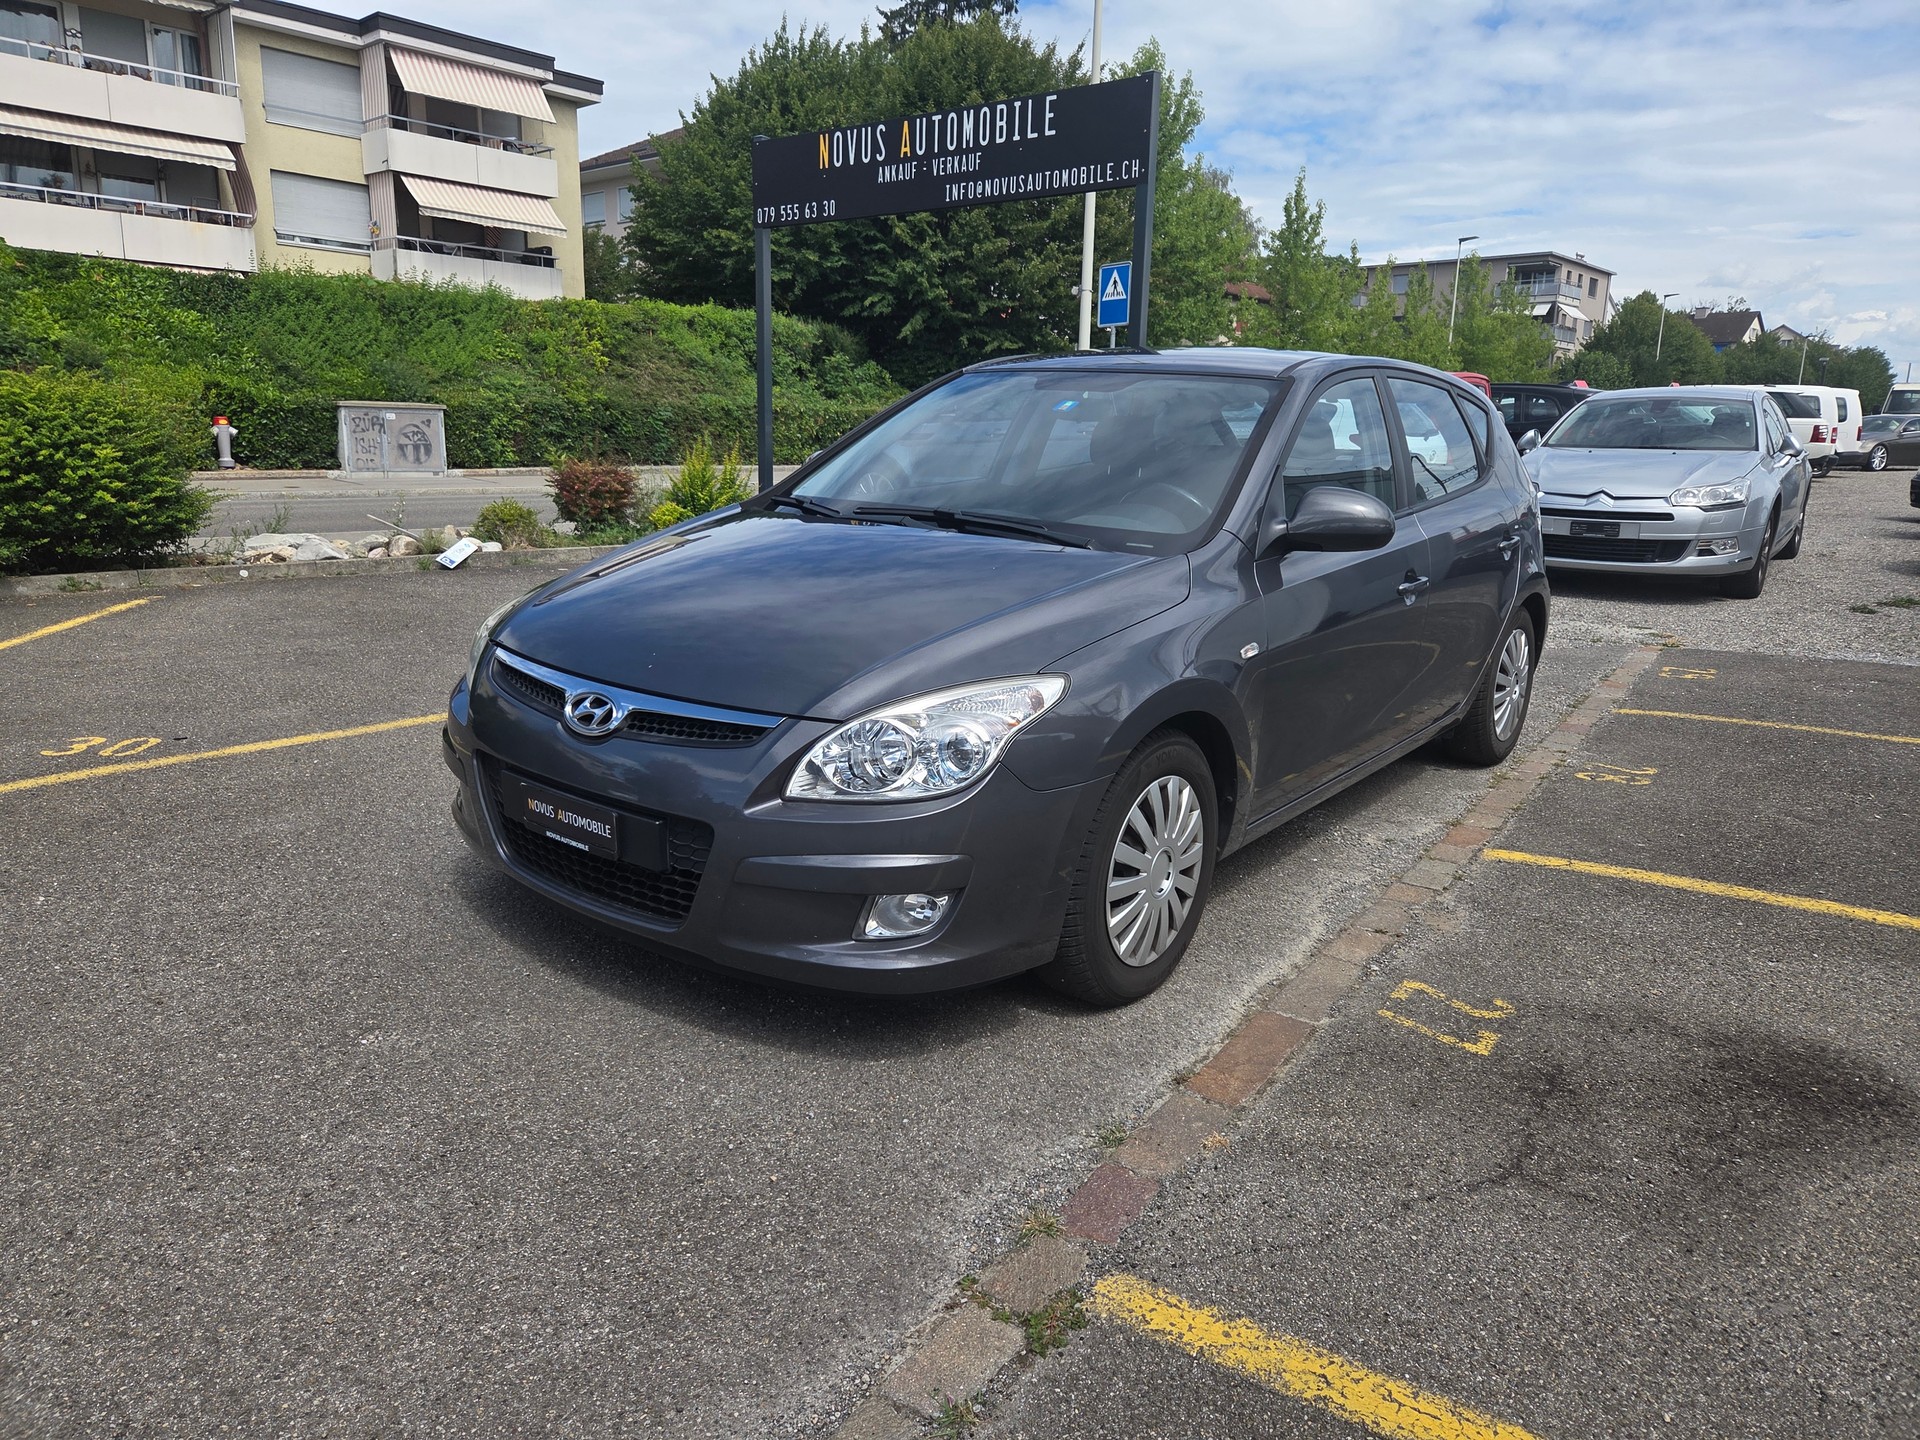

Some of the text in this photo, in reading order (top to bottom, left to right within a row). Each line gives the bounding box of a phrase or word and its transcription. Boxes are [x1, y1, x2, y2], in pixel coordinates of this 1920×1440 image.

[819, 94, 1058, 170] NOVUS AUTOMOBILE
[877, 161, 918, 184] ANKAUF
[932, 152, 982, 177] VERKAUF
[945, 158, 1140, 202] INFO@NOVUSAUTOMOBILE.CH
[757, 199, 836, 224] 079 555 63 30
[40, 736, 162, 757] 30
[527, 797, 612, 839] NOVUS AUTOMOBILE
[1377, 979, 1517, 1056] 27
